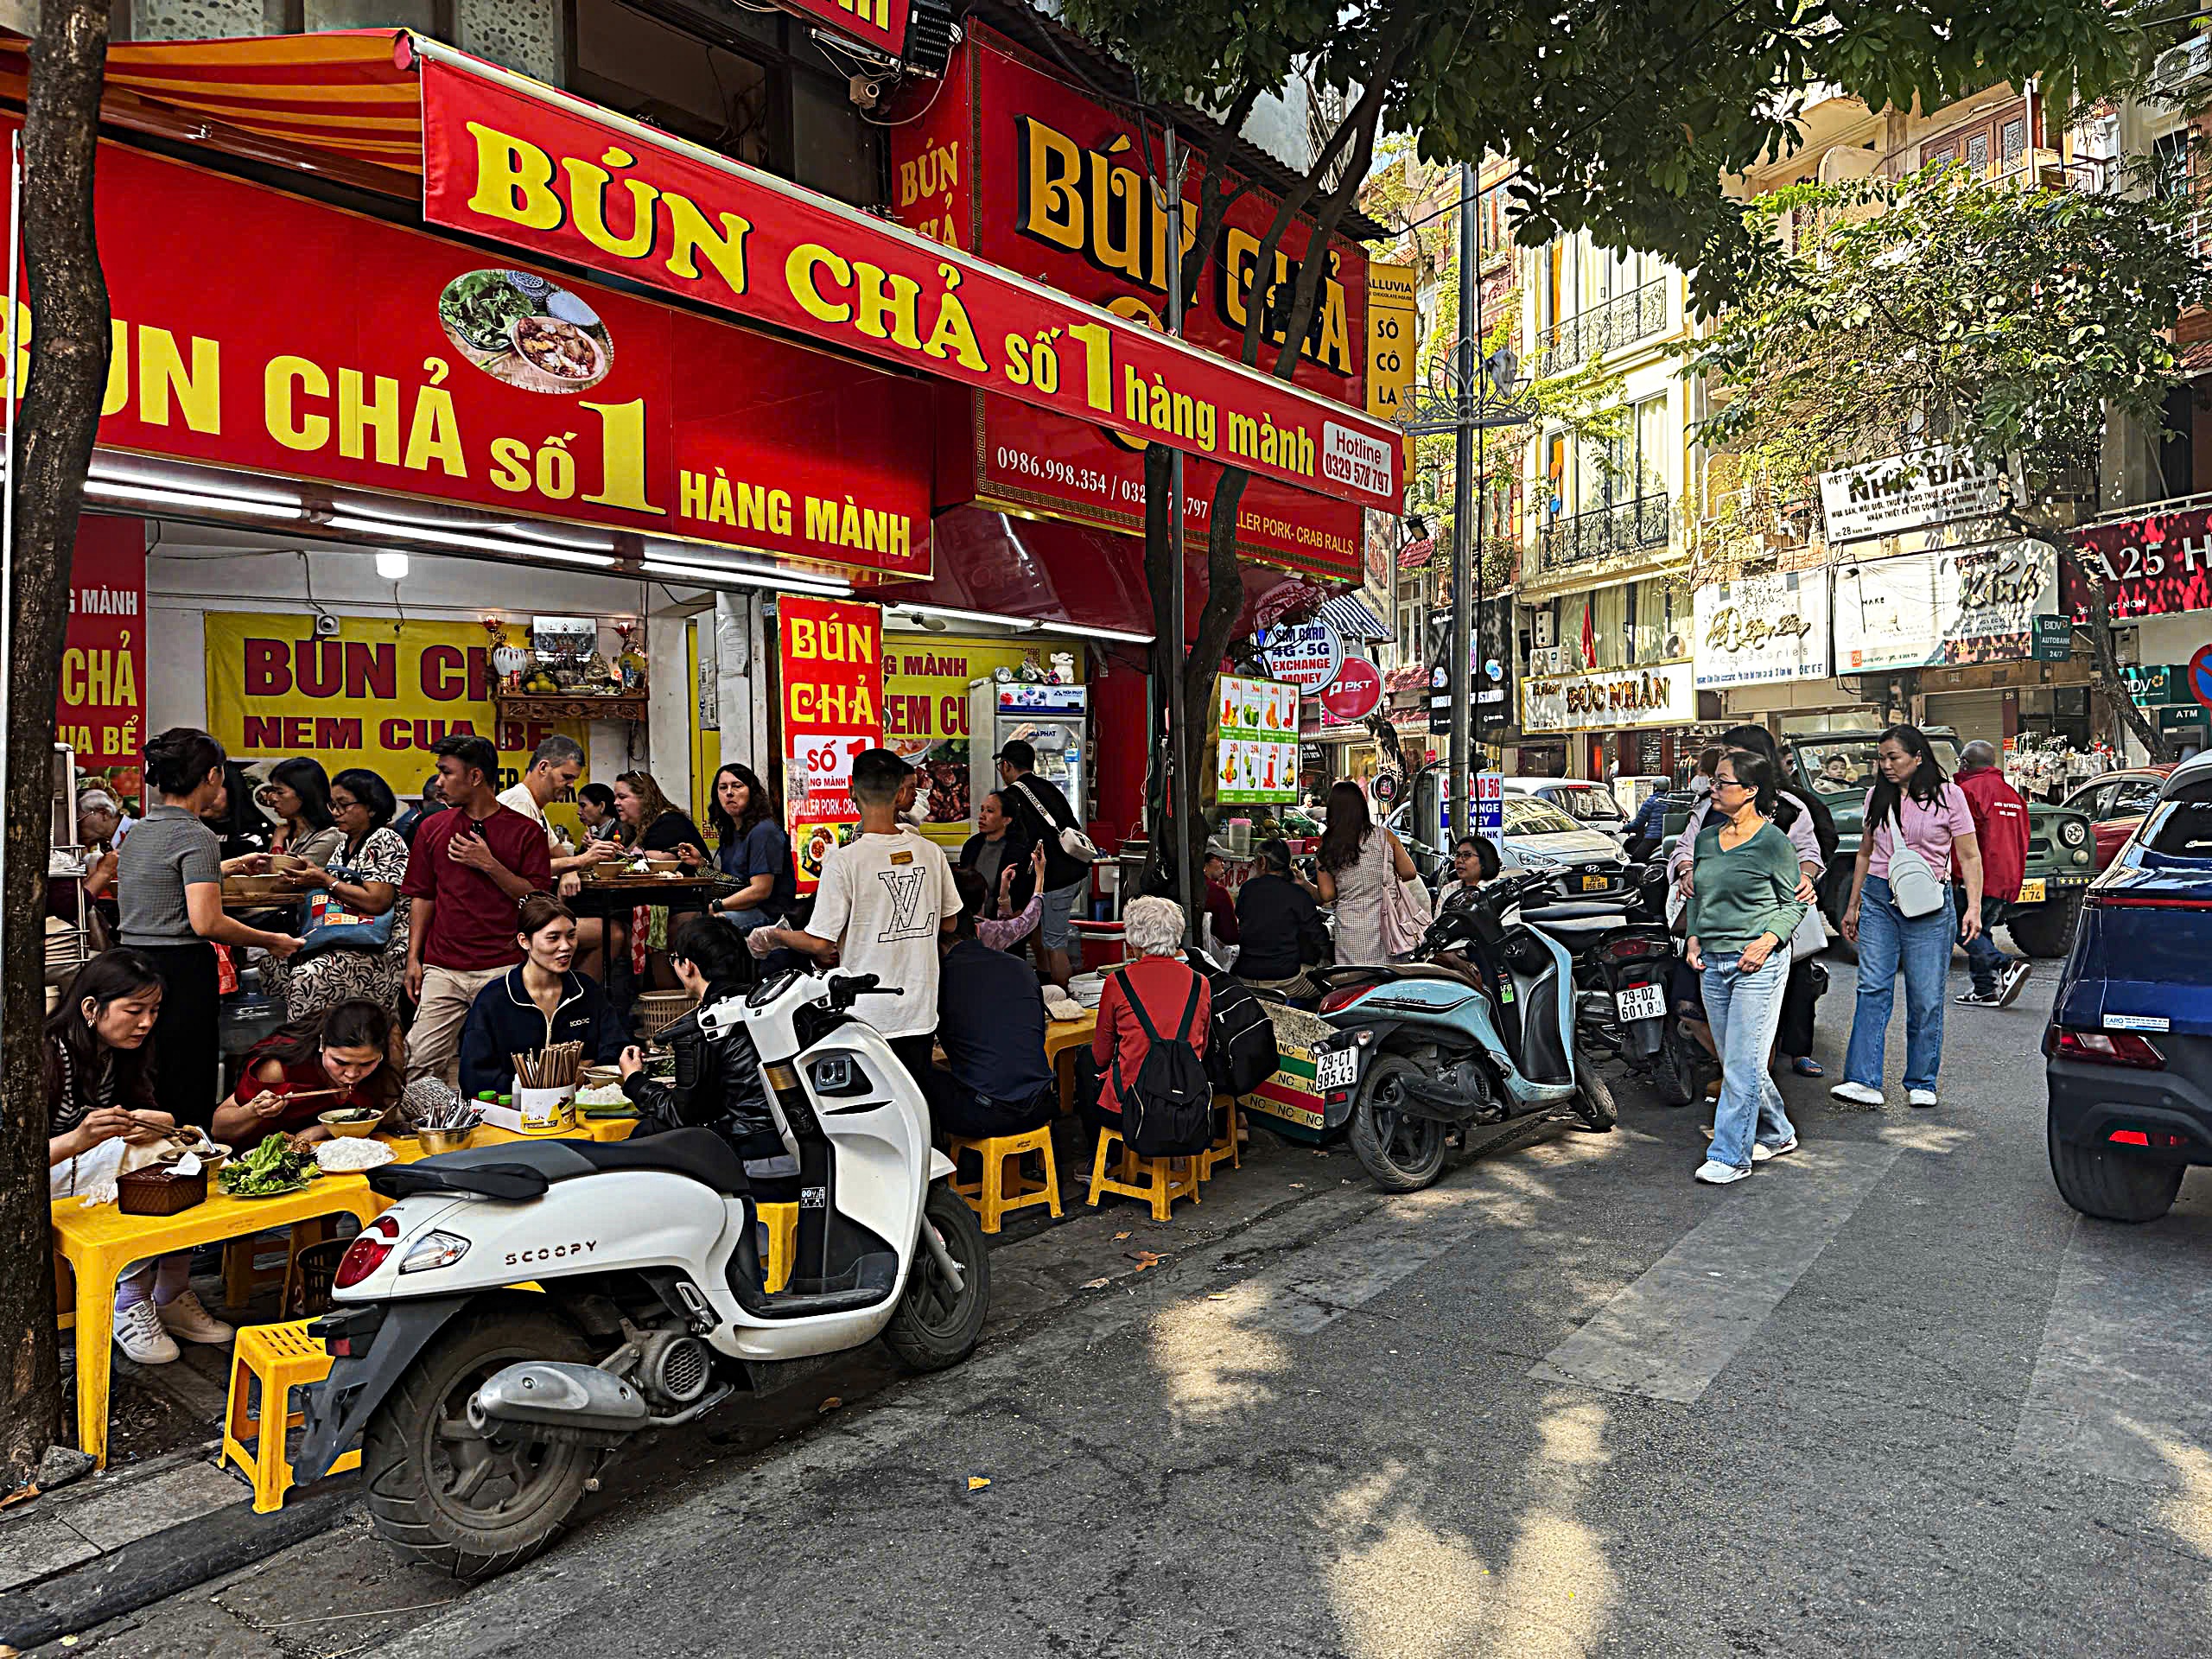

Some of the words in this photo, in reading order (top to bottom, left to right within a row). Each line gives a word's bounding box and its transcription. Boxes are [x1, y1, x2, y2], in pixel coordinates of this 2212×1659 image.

[899, 137, 958, 207] BÚN
[466, 121, 752, 295] BÚN
[785, 243, 990, 372] CHẢ
[1069, 321, 1115, 415] 1
[1125, 364, 1217, 452] hàng
[1228, 404, 1316, 477] mành
[1377, 317, 1399, 339] SÔ
[1376, 350, 1401, 372] CÔ
[1379, 385, 1397, 404] LA
[264, 356, 467, 479] CHẢ
[578, 398, 665, 515] 1
[680, 467, 793, 532] HÀNG
[806, 488, 911, 558] MÀNH
[1336, 429, 1382, 465] Hotline
[997, 446, 1107, 494] 0986.998.354
[1325, 454, 1352, 481] 0329
[1354, 461, 1371, 486] 578
[1372, 469, 1389, 493] 797
[1296, 526, 1323, 548] CRAB
[1325, 533, 1354, 555] RALLS
[82, 584, 137, 615] MÀNH
[2044, 620, 2063, 630] BIDV
[790, 612, 874, 664] BÚN
[1306, 642, 1330, 656] 5G
[2041, 636, 2070, 645] AUTOBANK
[62, 630, 138, 707] CHẢ
[244, 633, 397, 700] BÚN
[904, 652, 968, 677] MÀNH
[1272, 658, 1331, 671] EXCHANGE
[1344, 680, 1372, 690] PKT
[2123, 678, 2152, 693] IDV
[790, 674, 879, 726] CHẢ
[884, 695, 931, 734] EM
[2176, 709, 2198, 718] ATM
[103, 715, 139, 756] BỂ
[243, 715, 363, 750] NEM
[807, 740, 836, 772] SỐ
[823, 776, 846, 787] MÀNH
[1488, 778, 1500, 798] 5G
[1622, 987, 1656, 1006] 29-D2
[1621, 1001, 1662, 1020] 601.8
[1278, 1043, 1295, 1055] NC
[1322, 1050, 1351, 1071] 29-C1
[1278, 1072, 1295, 1086] NC
[1318, 1066, 1353, 1090] 985.43
[1249, 1096, 1266, 1109] NC
[1277, 1104, 1294, 1118] NC
[1306, 1113, 1323, 1127] NC
[505, 1239, 598, 1267] SCOOPY
